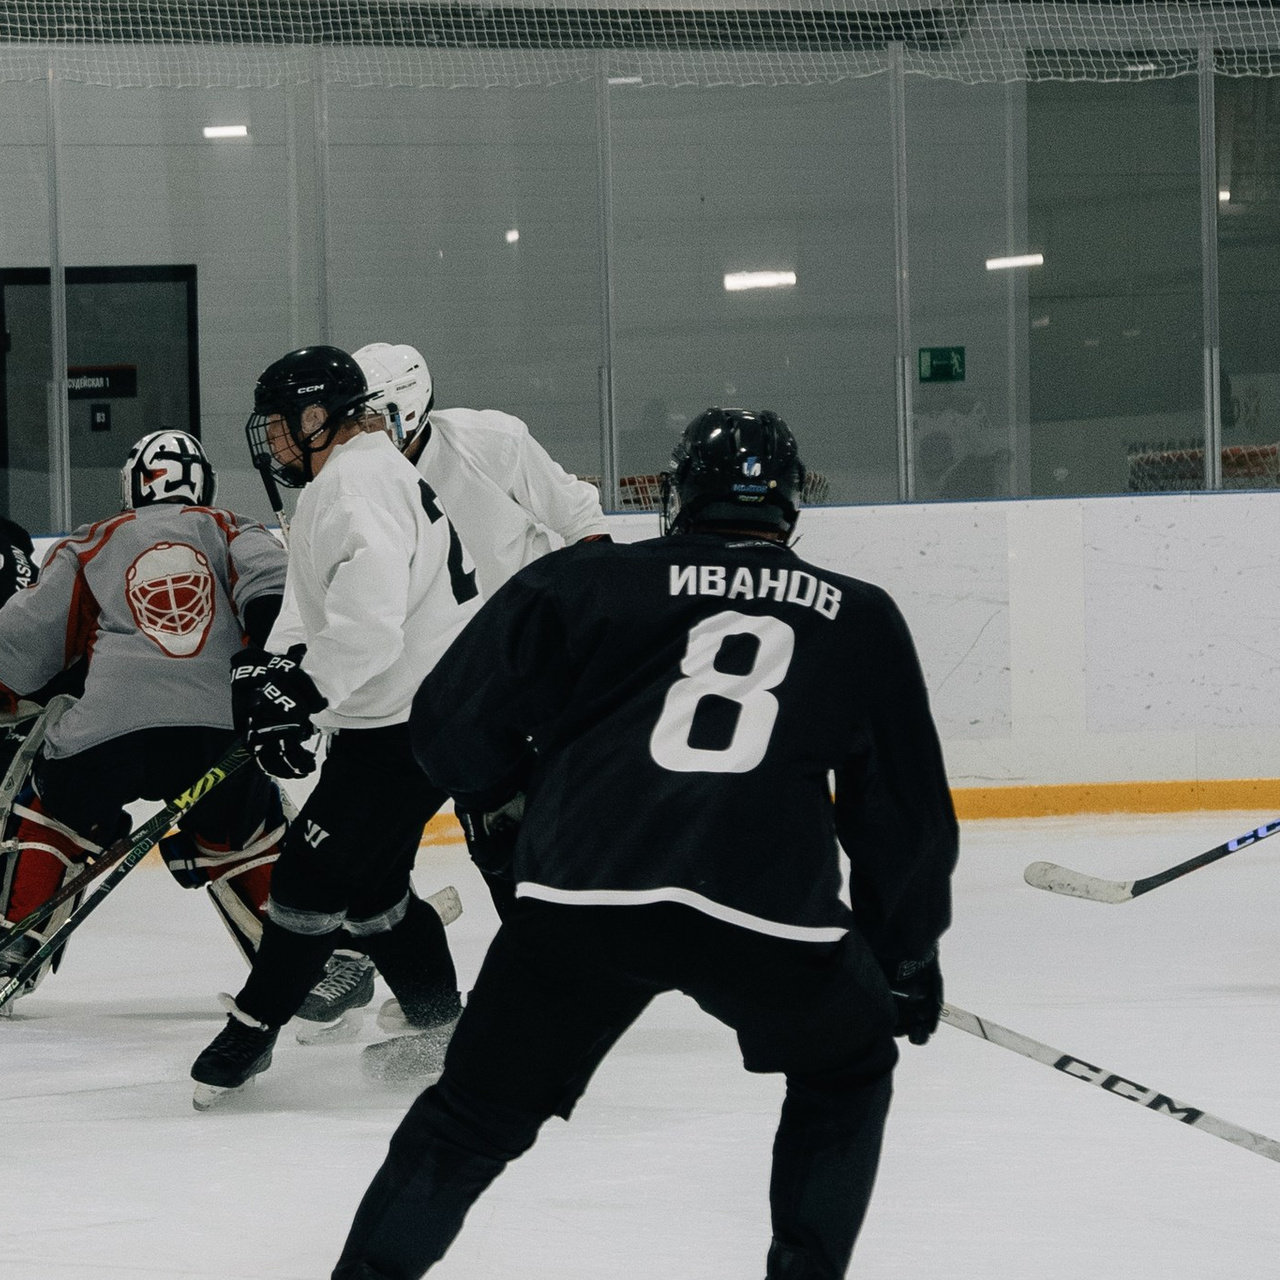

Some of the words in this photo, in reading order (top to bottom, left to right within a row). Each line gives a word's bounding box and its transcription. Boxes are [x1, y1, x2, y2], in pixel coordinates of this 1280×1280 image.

[297, 383, 325, 395] CCM
[669, 564, 843, 621] ИВАНОВ
[649, 609, 796, 774] 8
[1053, 1054, 1205, 1125] CCM
